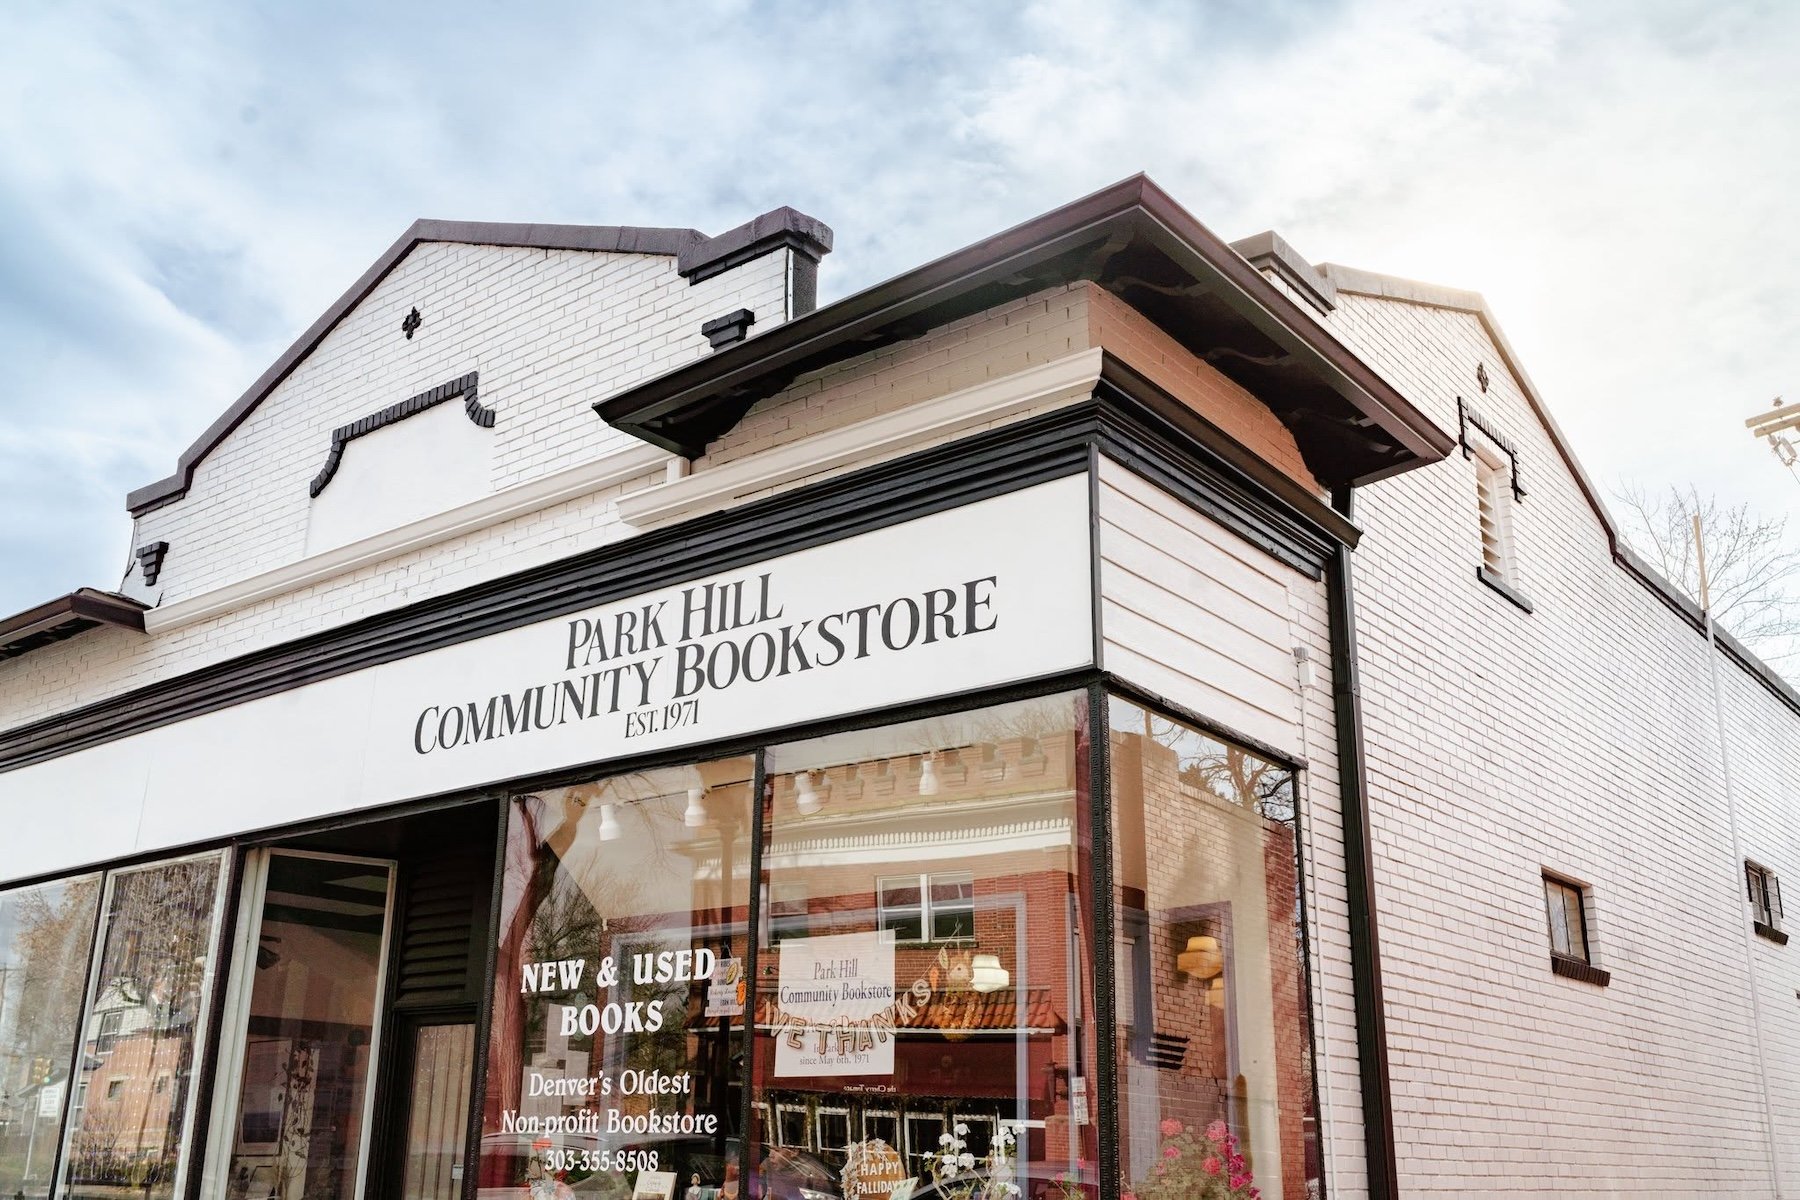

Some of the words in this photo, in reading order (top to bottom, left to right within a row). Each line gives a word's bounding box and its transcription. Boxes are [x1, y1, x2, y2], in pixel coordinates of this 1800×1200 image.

[565, 600, 669, 671] PARK
[677, 572, 785, 643] HILL
[414, 656, 664, 754] COMMUNITY
[671, 575, 998, 699] BOOKSTORE
[624, 710, 659, 739] EST.
[663, 698, 699, 729] 1971
[520, 959, 585, 993] NEW
[596, 956, 619, 988] &
[813, 960, 836, 980] Park
[839, 959, 858, 978] Hill
[780, 985, 839, 1007] Community
[841, 981, 892, 1001] Bookstore
[560, 1000, 664, 1036] BOOKS
[815, 979, 931, 1056] THANKS
[818, 1055, 834, 1067] May
[854, 1054, 870, 1064] 1971
[528, 1070, 611, 1096] Denver's
[620, 1069, 691, 1095] Oldest
[501, 1109, 599, 1138] Non-profit
[606, 1108, 717, 1134] Bookstore
[544, 1150, 659, 1172] 303-355-8508
[860, 1162, 899, 1176] HAPPY
